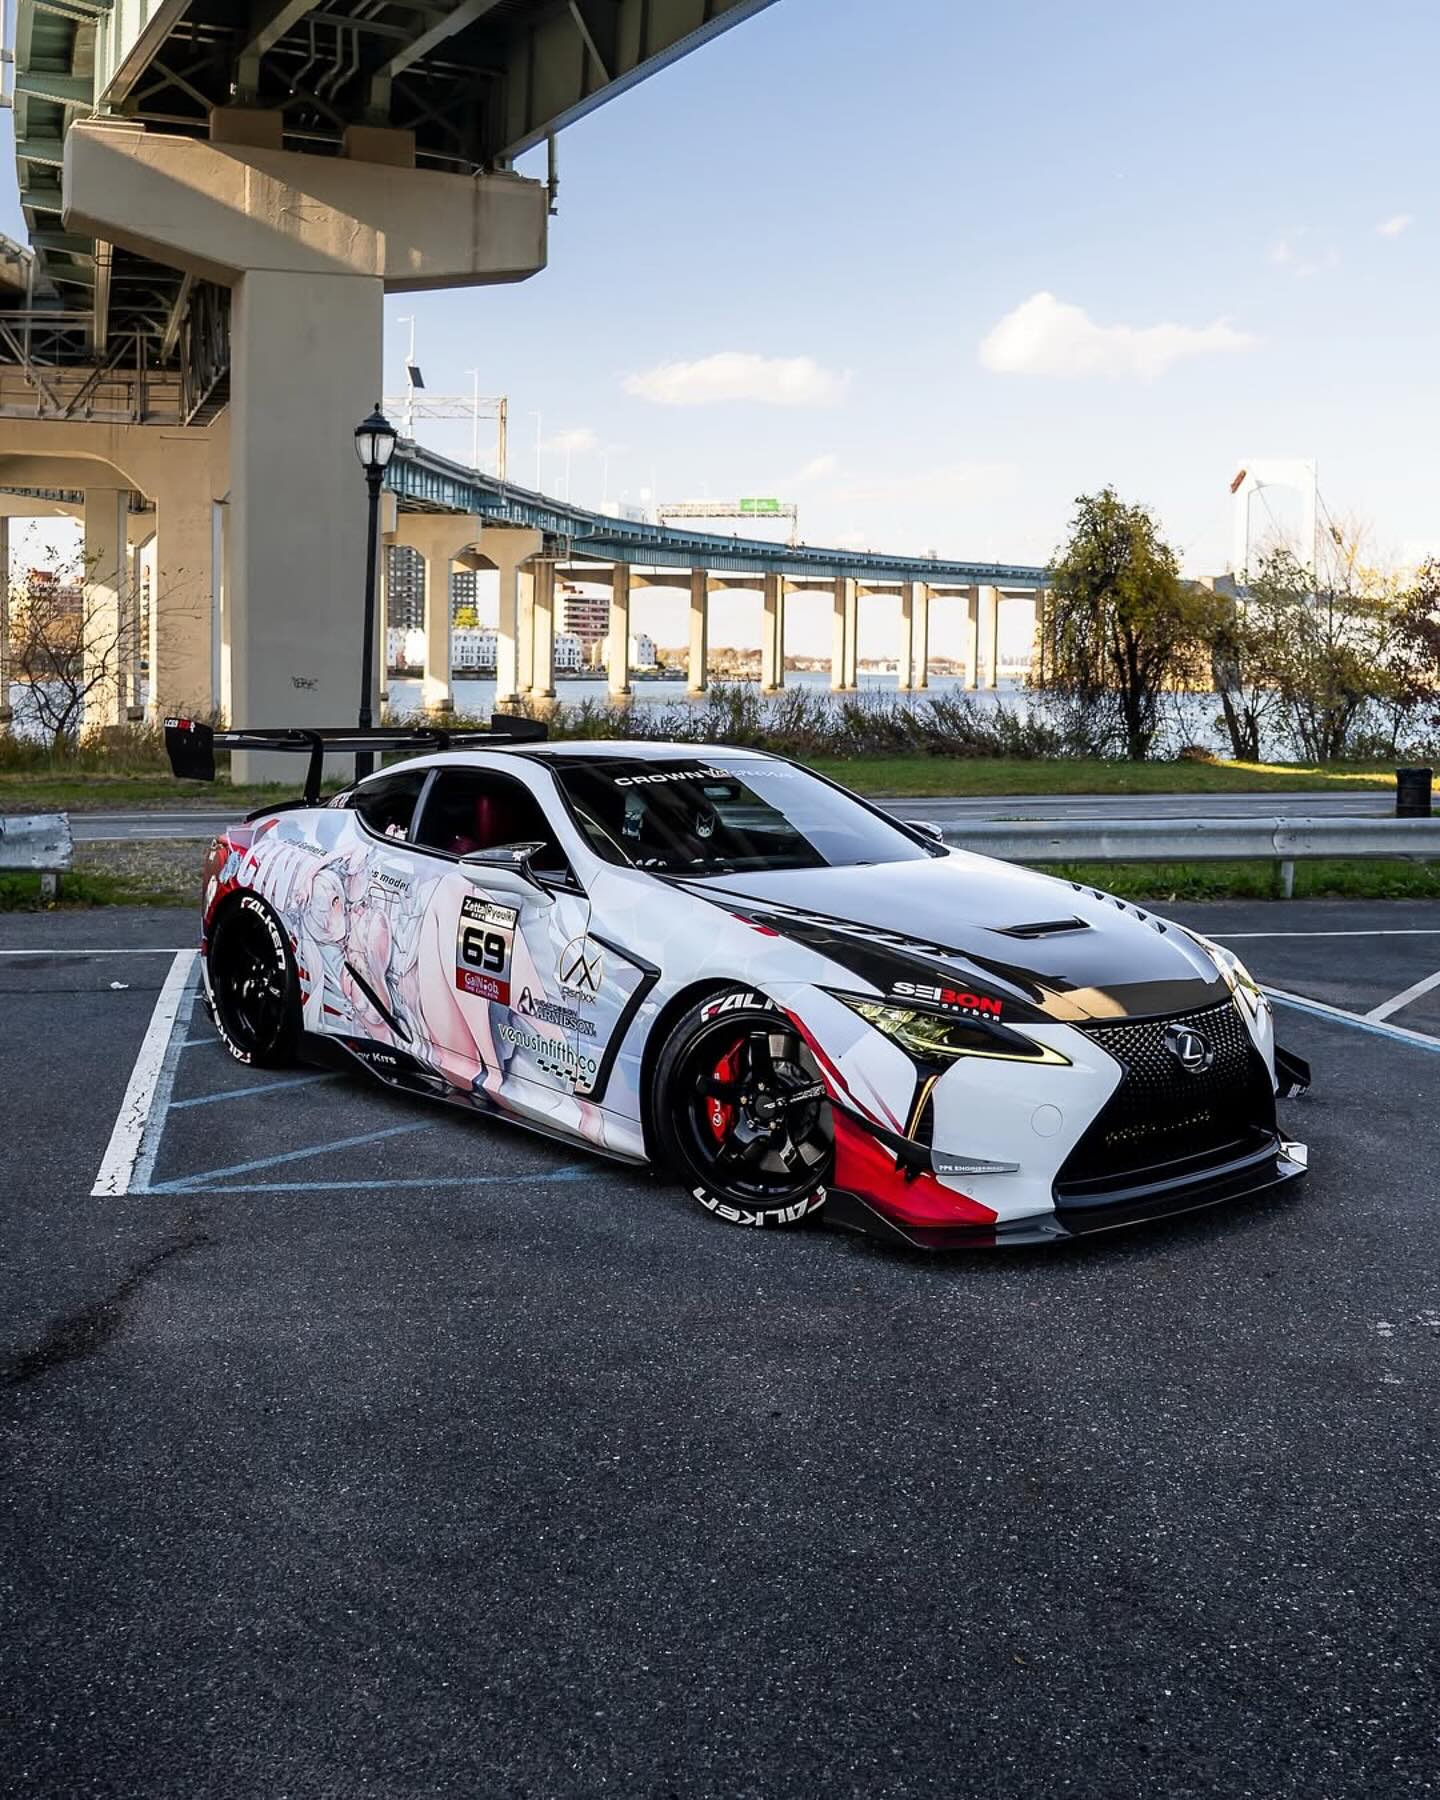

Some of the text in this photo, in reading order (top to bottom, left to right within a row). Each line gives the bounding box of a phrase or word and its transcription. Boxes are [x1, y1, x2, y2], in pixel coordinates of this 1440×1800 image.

[613, 769, 703, 787] CROWN
[379, 873, 411, 892] model
[462, 926, 506, 974] 69
[700, 993, 781, 1023] FALK
[891, 981, 1003, 1016] SEIBON
[941, 1003, 1000, 1022] carbon
[692, 1185, 828, 1226] FALKEN
